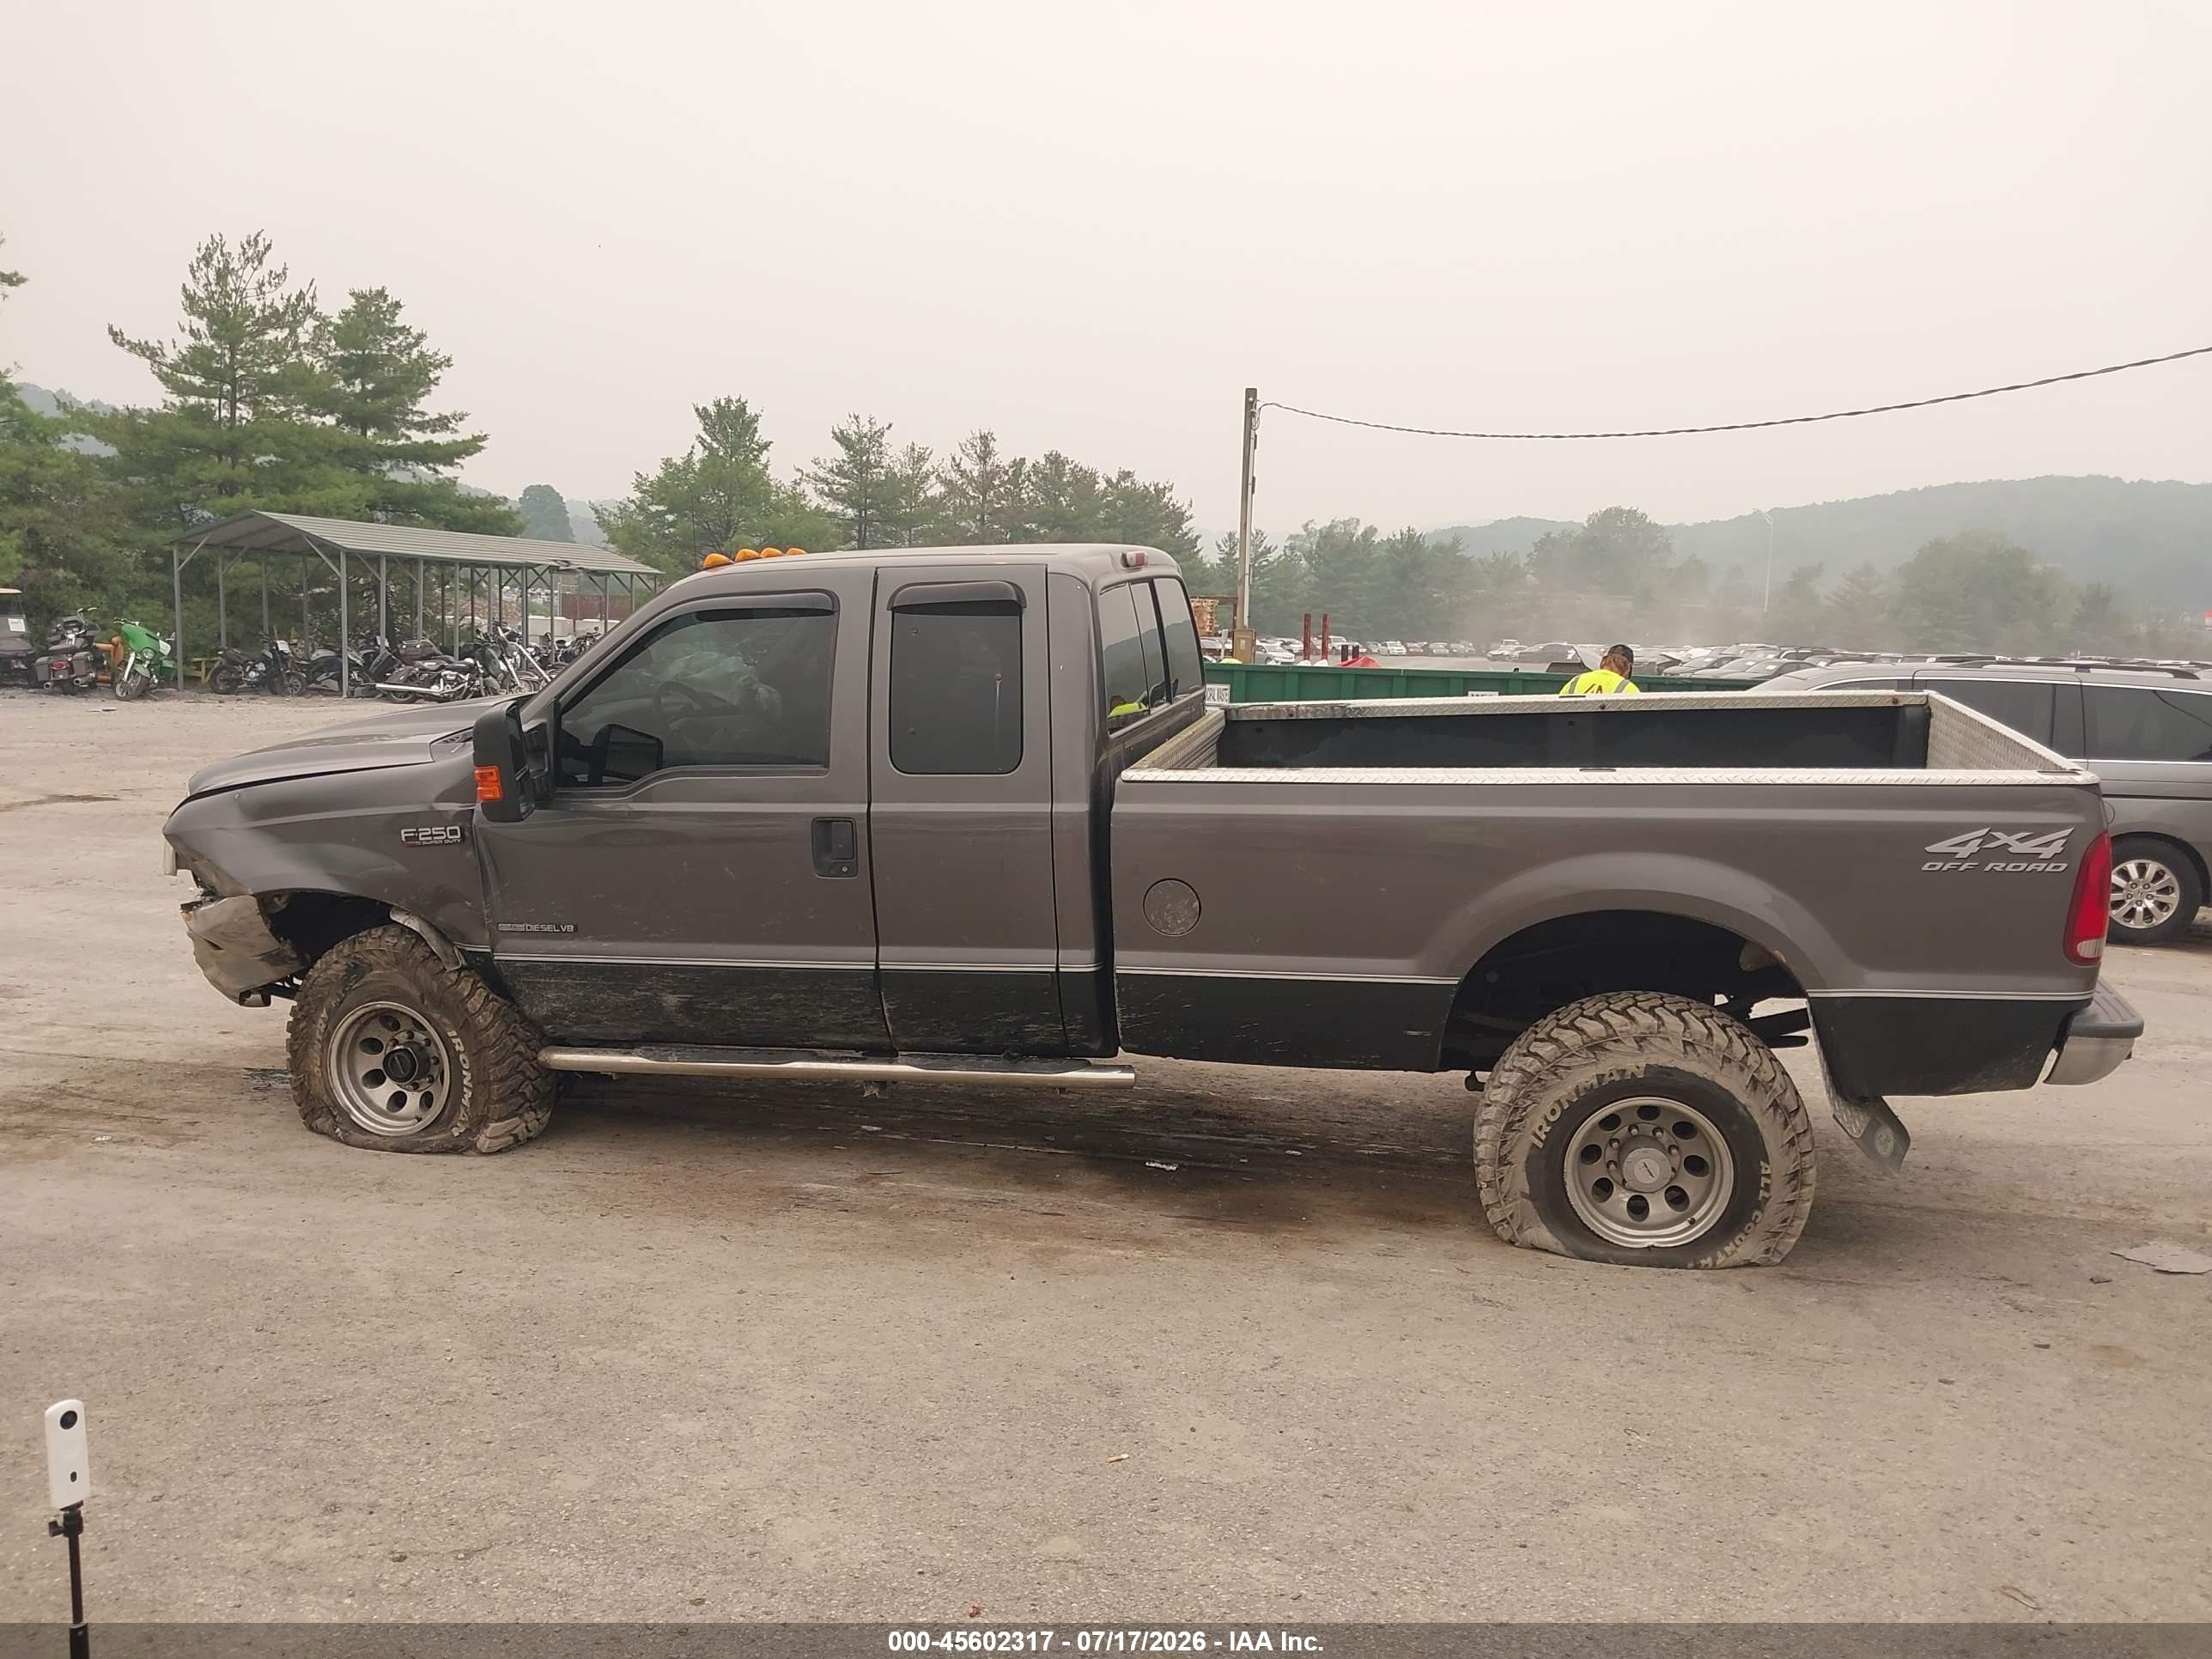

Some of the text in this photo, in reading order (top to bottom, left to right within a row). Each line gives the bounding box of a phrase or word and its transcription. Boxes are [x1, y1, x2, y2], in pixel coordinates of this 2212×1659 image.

[1921, 861, 2069, 873] OFF ROAD
[526, 924, 560, 933] DIESEL
[447, 1030, 473, 1137] IRONMAN
[1531, 1064, 1646, 1149] IRONMAN
[1758, 1161, 1772, 1200] ALL
